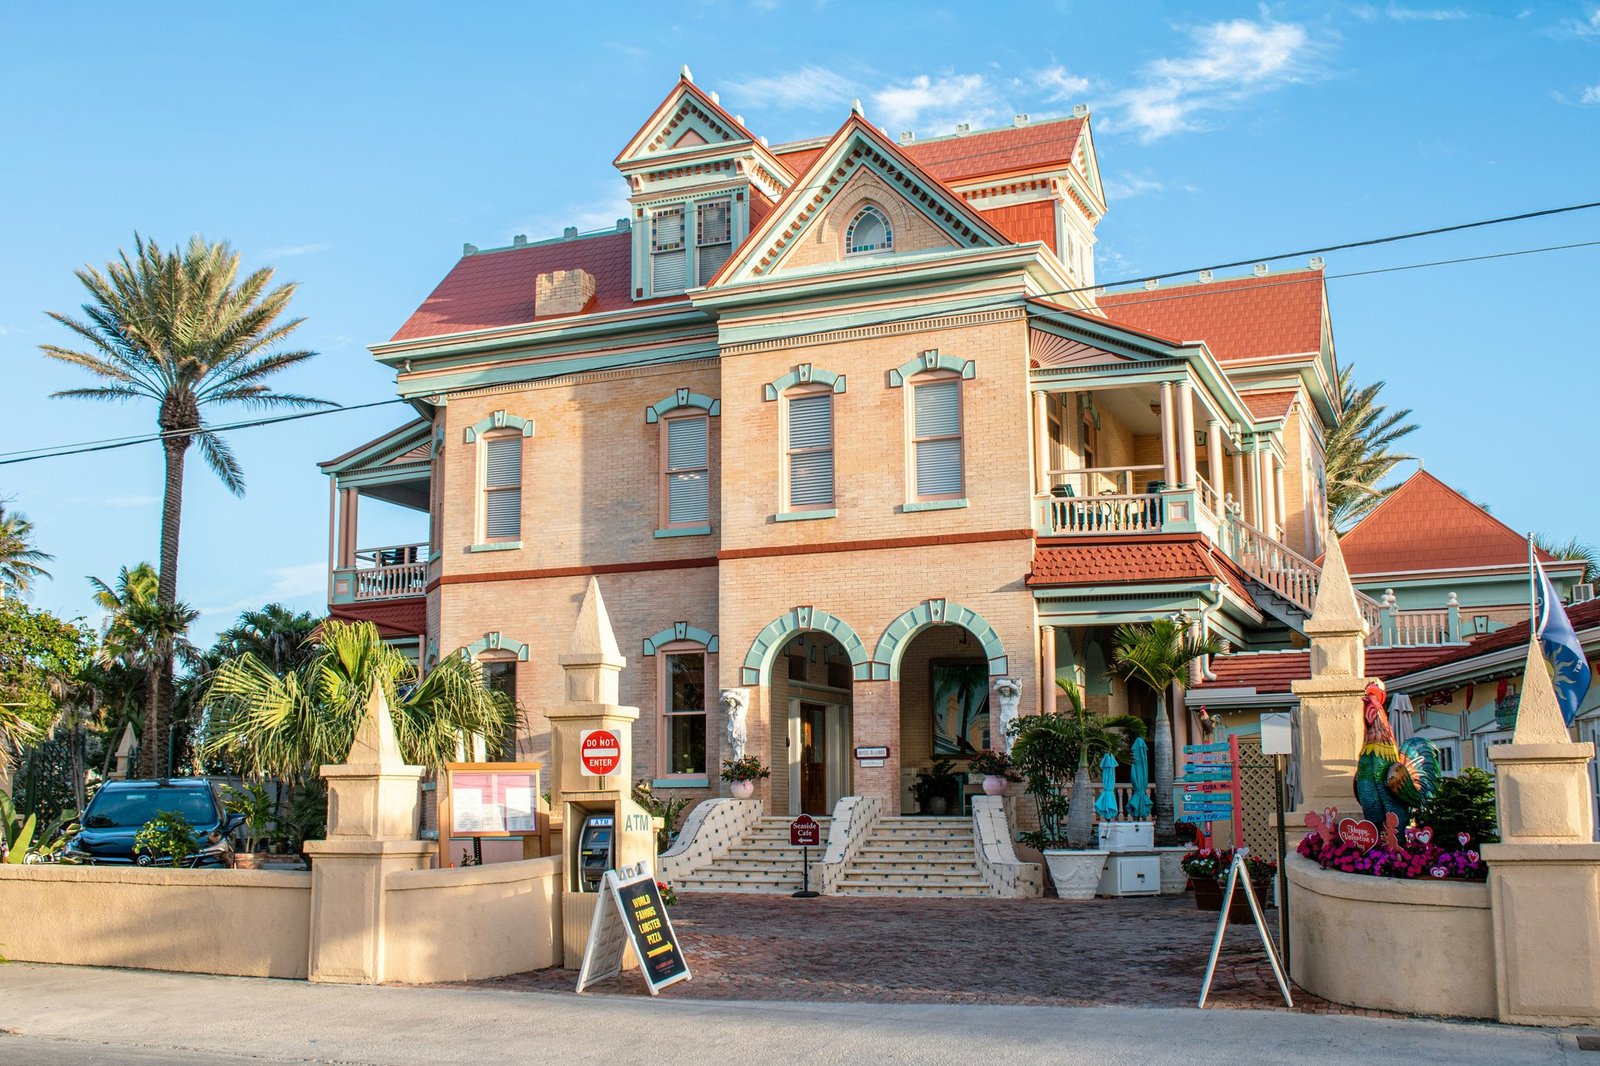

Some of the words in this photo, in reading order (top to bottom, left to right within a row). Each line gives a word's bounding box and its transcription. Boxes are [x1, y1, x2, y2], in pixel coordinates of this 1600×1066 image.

[586, 739, 597, 747] DO
[600, 738, 615, 747] NOT
[589, 758, 612, 767] ENTER
[625, 814, 648, 831] ATM
[1347, 825, 1368, 836] Happy
[632, 894, 651, 908] WORLD
[635, 906, 657, 921] FAMOUS
[639, 918, 661, 934] LOBSTER
[646, 931, 662, 945] PIZZA
